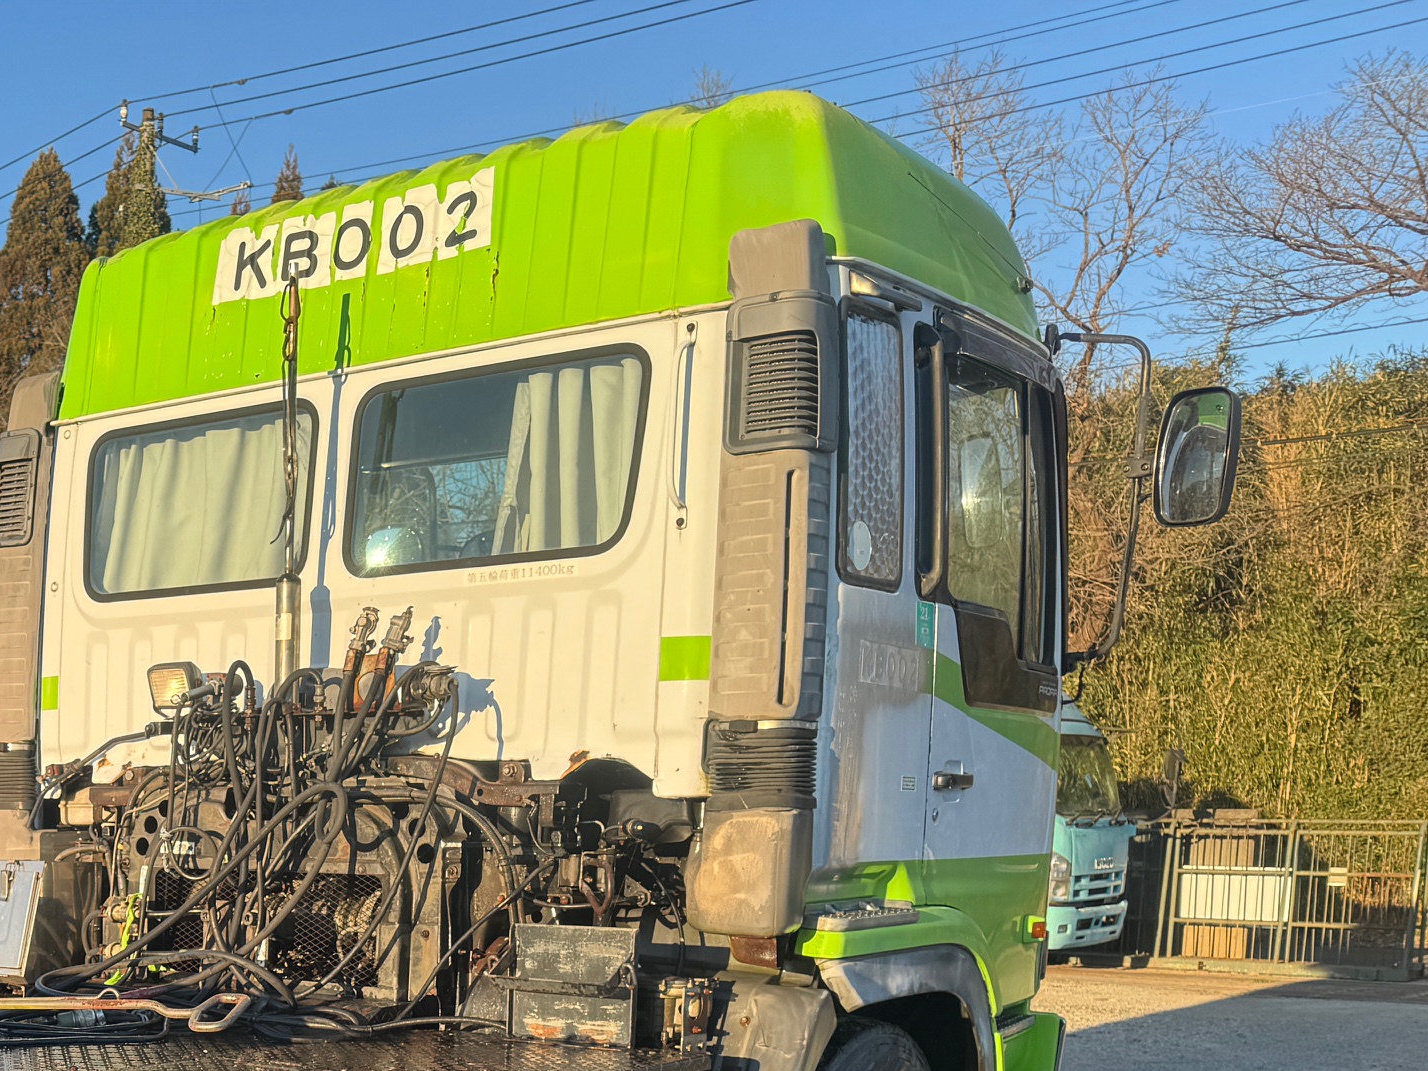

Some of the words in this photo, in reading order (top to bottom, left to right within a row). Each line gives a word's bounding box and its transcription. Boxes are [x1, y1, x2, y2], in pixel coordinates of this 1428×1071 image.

[233, 190, 478, 292] KB002
[467, 564, 575, 584] 第五輪荷重11400kg
